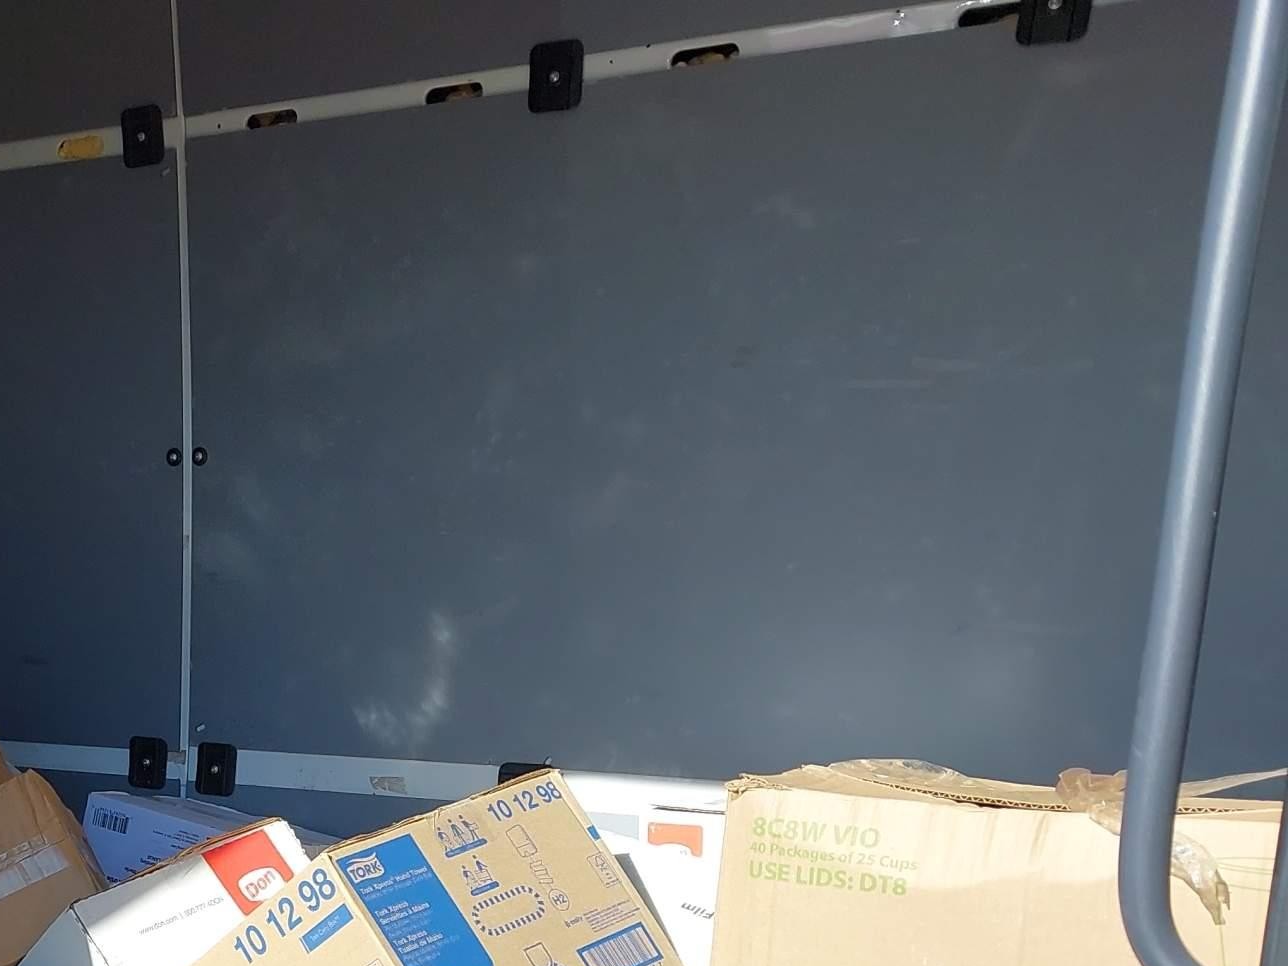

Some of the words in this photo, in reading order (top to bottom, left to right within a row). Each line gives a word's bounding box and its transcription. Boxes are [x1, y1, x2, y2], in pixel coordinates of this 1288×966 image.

[488, 800, 513, 822] 10
[513, 790, 540, 812] 12
[536, 781, 562, 804] 98
[752, 817, 826, 843] 8C8W
[833, 825, 881, 848] VIO
[349, 858, 381, 881] TORK
[770, 843, 835, 863] Packages
[838, 852, 854, 864] of
[857, 853, 875, 865] 25
[880, 856, 919, 872] Cups
[245, 870, 276, 898] Don
[749, 860, 790, 882] USE
[796, 866, 854, 890] LIDS:
[860, 873, 907, 896] DT8
[552, 893, 567, 905] H2
[234, 925, 267, 964] 10
[266, 897, 303, 937] 12
[298, 868, 336, 912] 98
